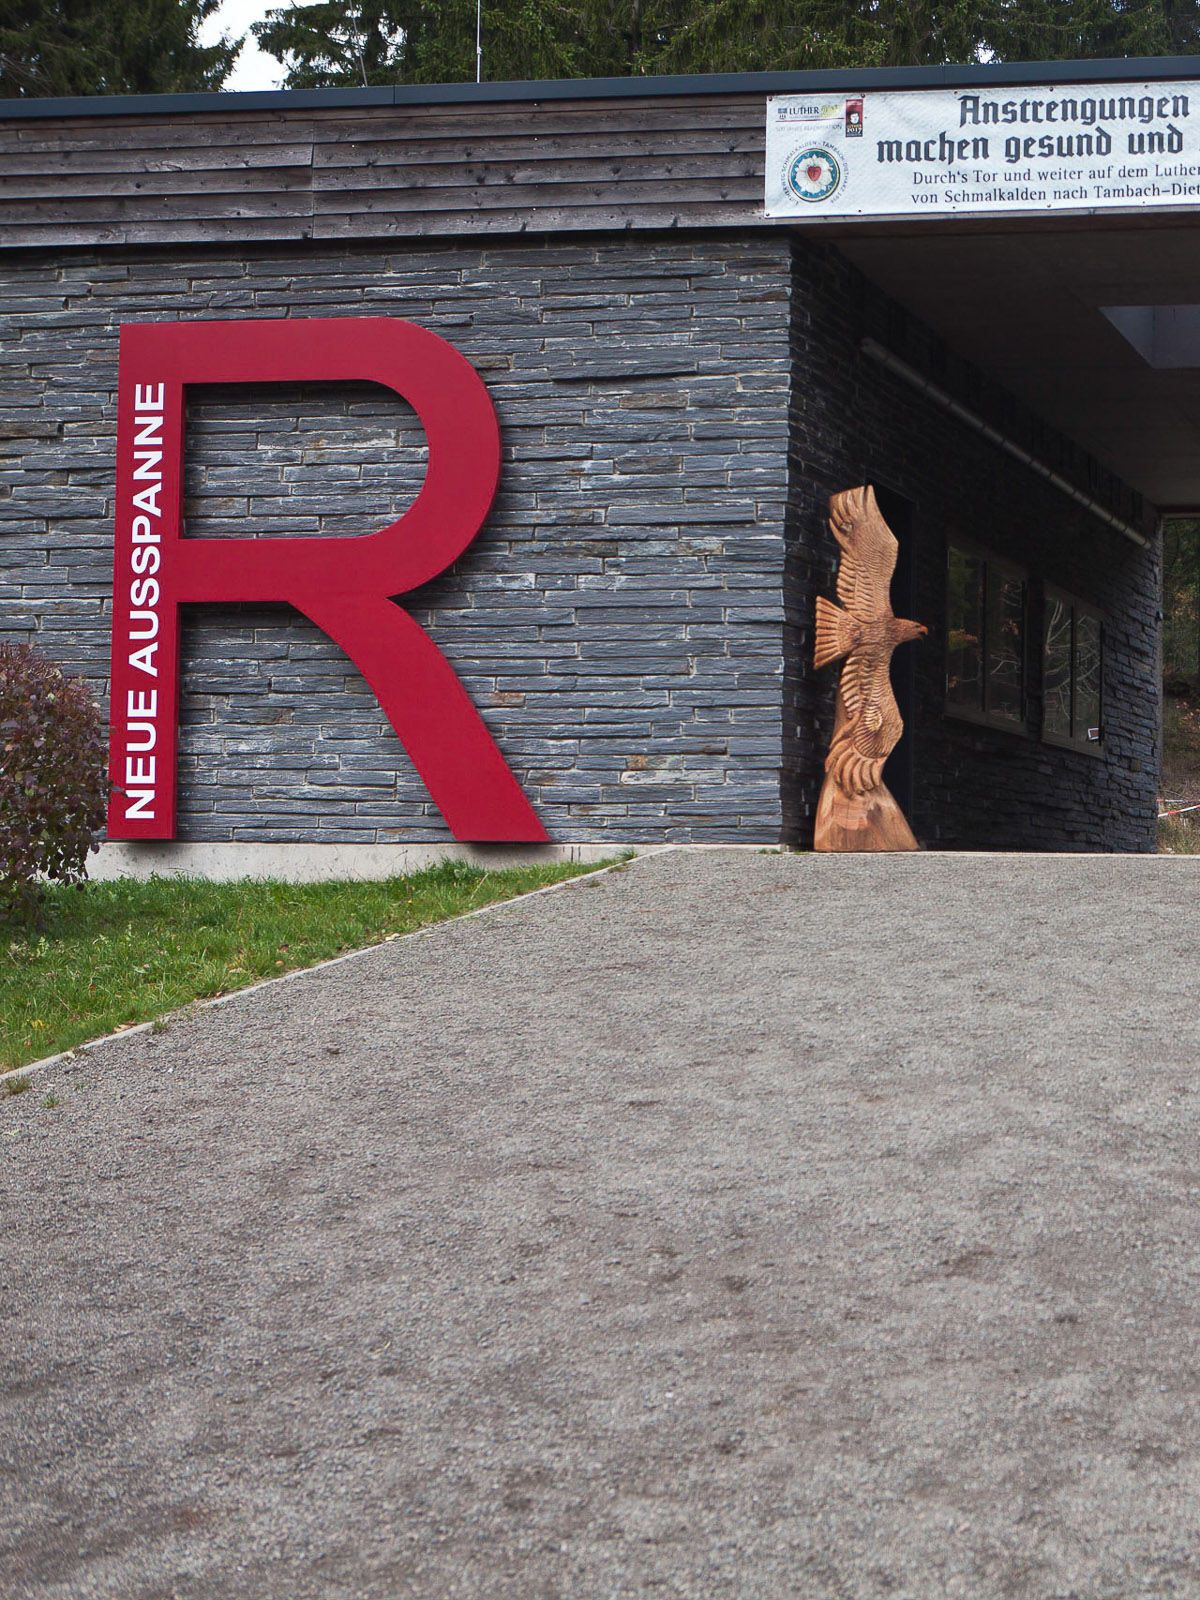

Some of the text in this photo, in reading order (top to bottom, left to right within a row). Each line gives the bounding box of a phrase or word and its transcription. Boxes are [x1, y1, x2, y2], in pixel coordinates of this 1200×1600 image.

[790, 106, 819, 115] LUTHER
[957, 95, 1190, 127] Anstrengungen
[877, 131, 989, 165] machen
[1004, 126, 1112, 164] gesund
[1127, 123, 1183, 155] und
[973, 169, 998, 183] Tor
[1004, 168, 1032, 182] und
[1037, 168, 1084, 181] weiter
[1089, 165, 1114, 179] auf
[1118, 165, 1148, 178] dem
[912, 193, 938, 204] von
[944, 187, 1046, 202] Schmalkalden
[1053, 186, 1088, 200] nach
[106, 316, 552, 842] R
[125, 382, 165, 820] NEUE AUSSPANNE
